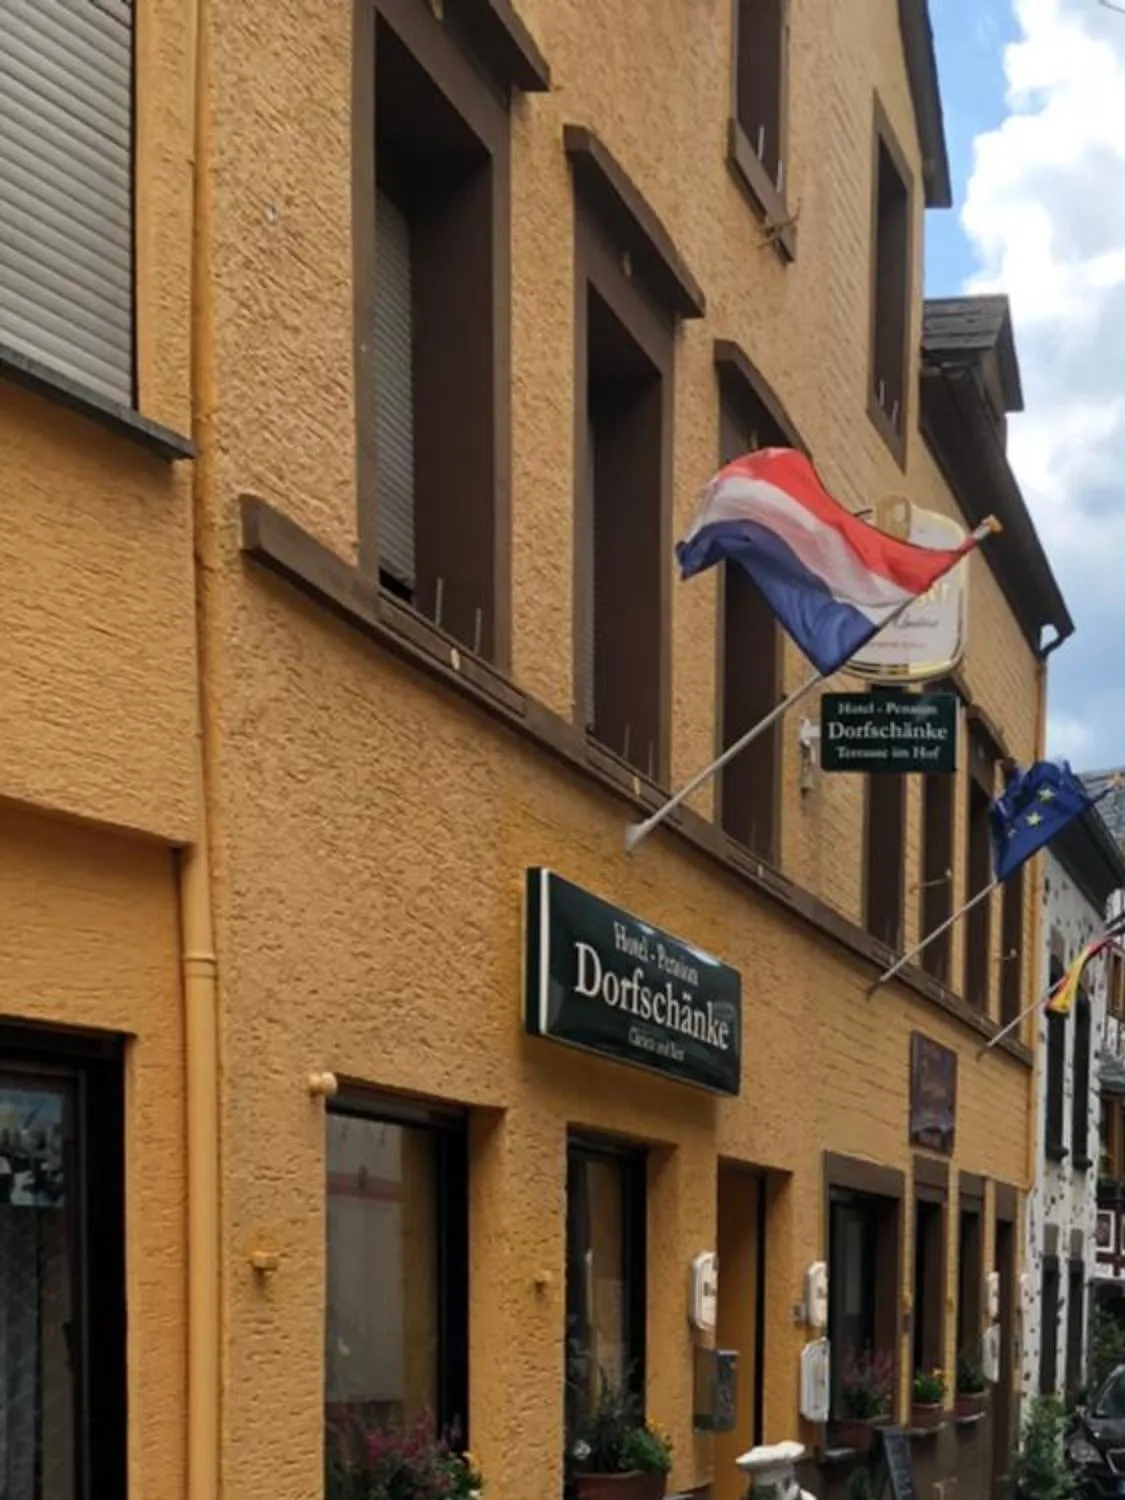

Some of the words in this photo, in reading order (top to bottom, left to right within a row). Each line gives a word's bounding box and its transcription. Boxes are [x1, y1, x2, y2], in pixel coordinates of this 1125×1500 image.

[828, 721, 949, 740] Dorfschänke
[613, 921, 650, 963] Hotel
[574, 941, 729, 1051] Dorfschänke
